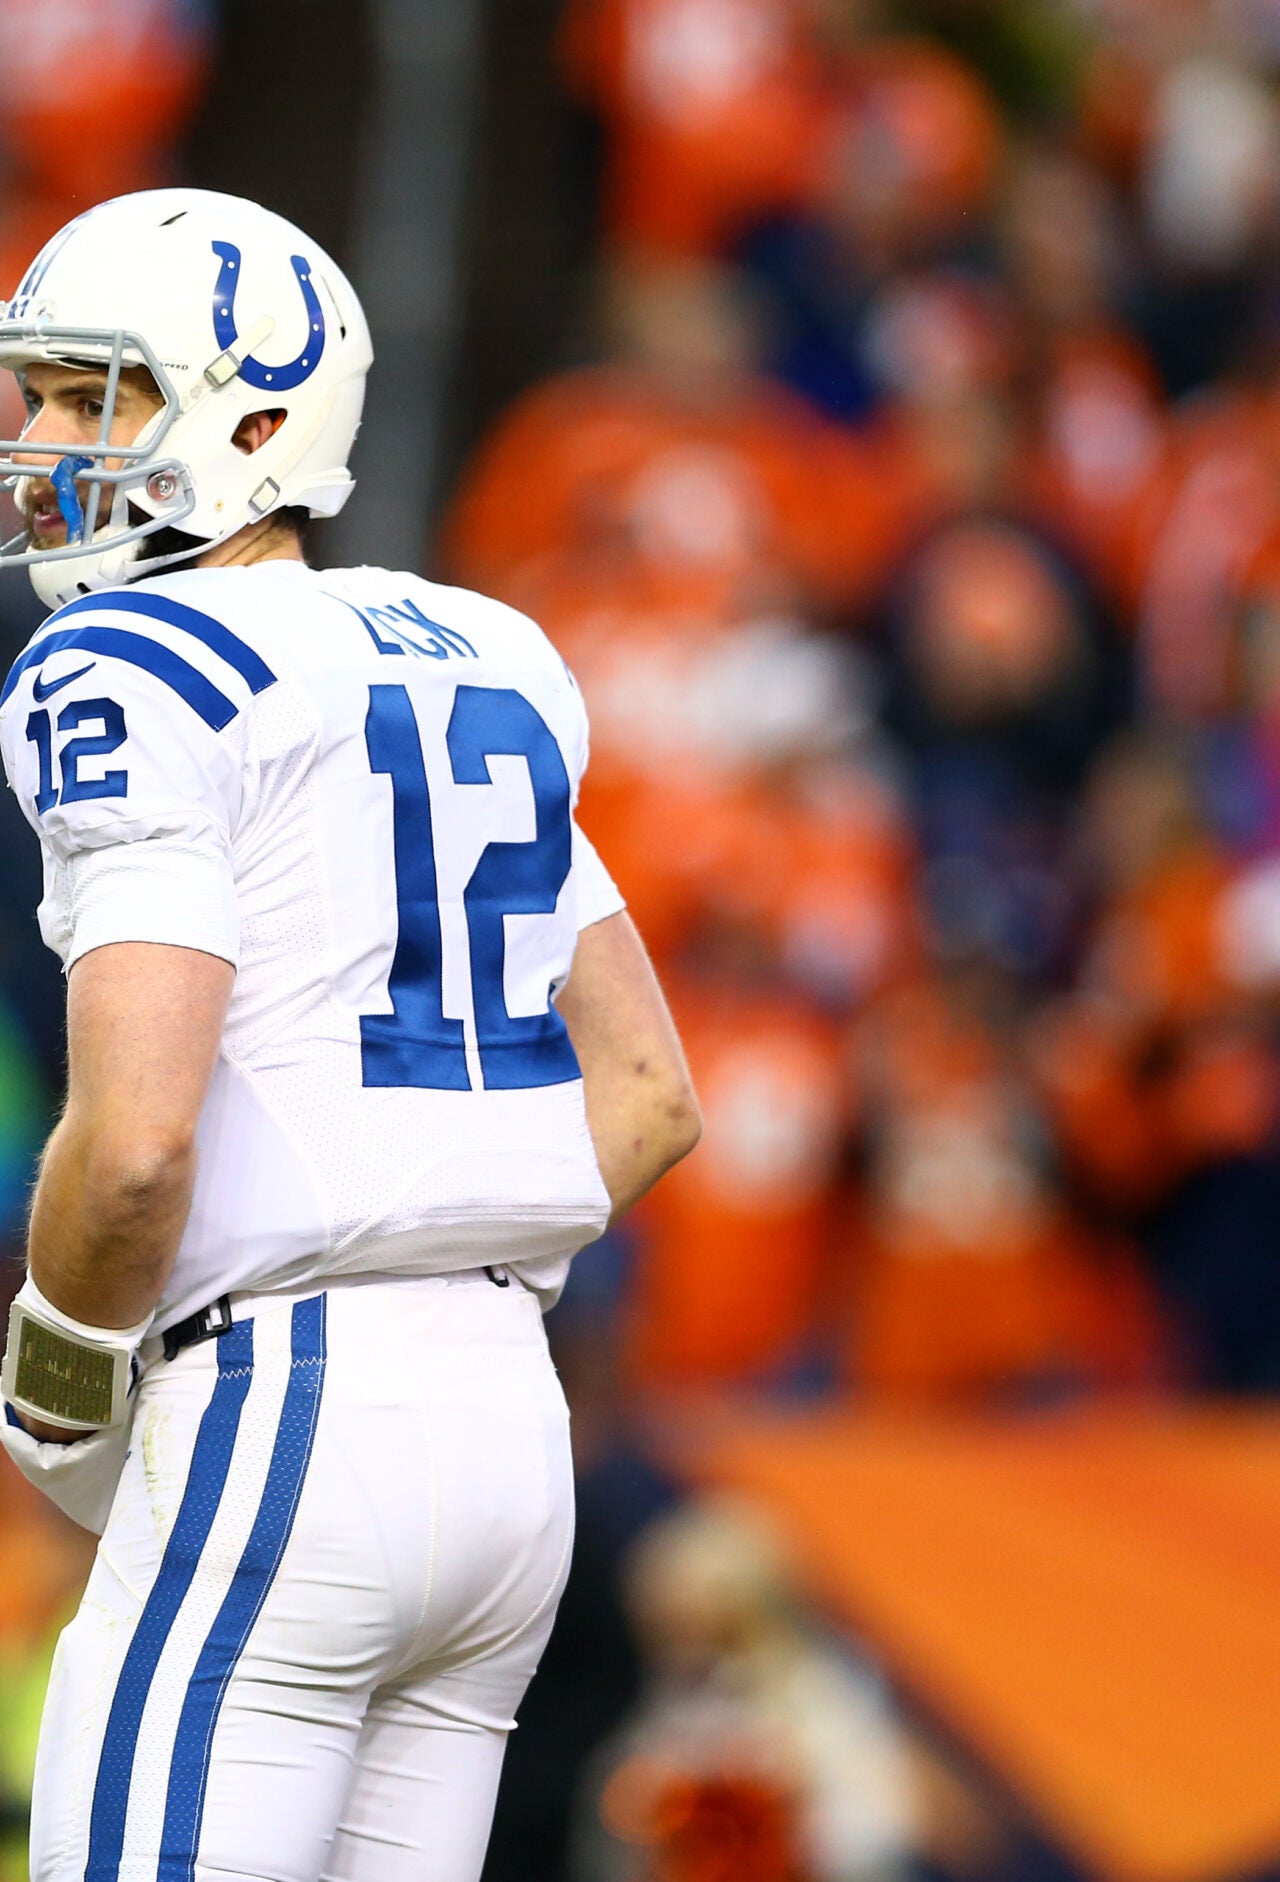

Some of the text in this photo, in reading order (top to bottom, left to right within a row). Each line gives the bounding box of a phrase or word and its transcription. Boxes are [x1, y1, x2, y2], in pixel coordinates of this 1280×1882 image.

[322, 592, 479, 660] LCK
[26, 697, 128, 815] 12
[360, 685, 582, 1091] 12
